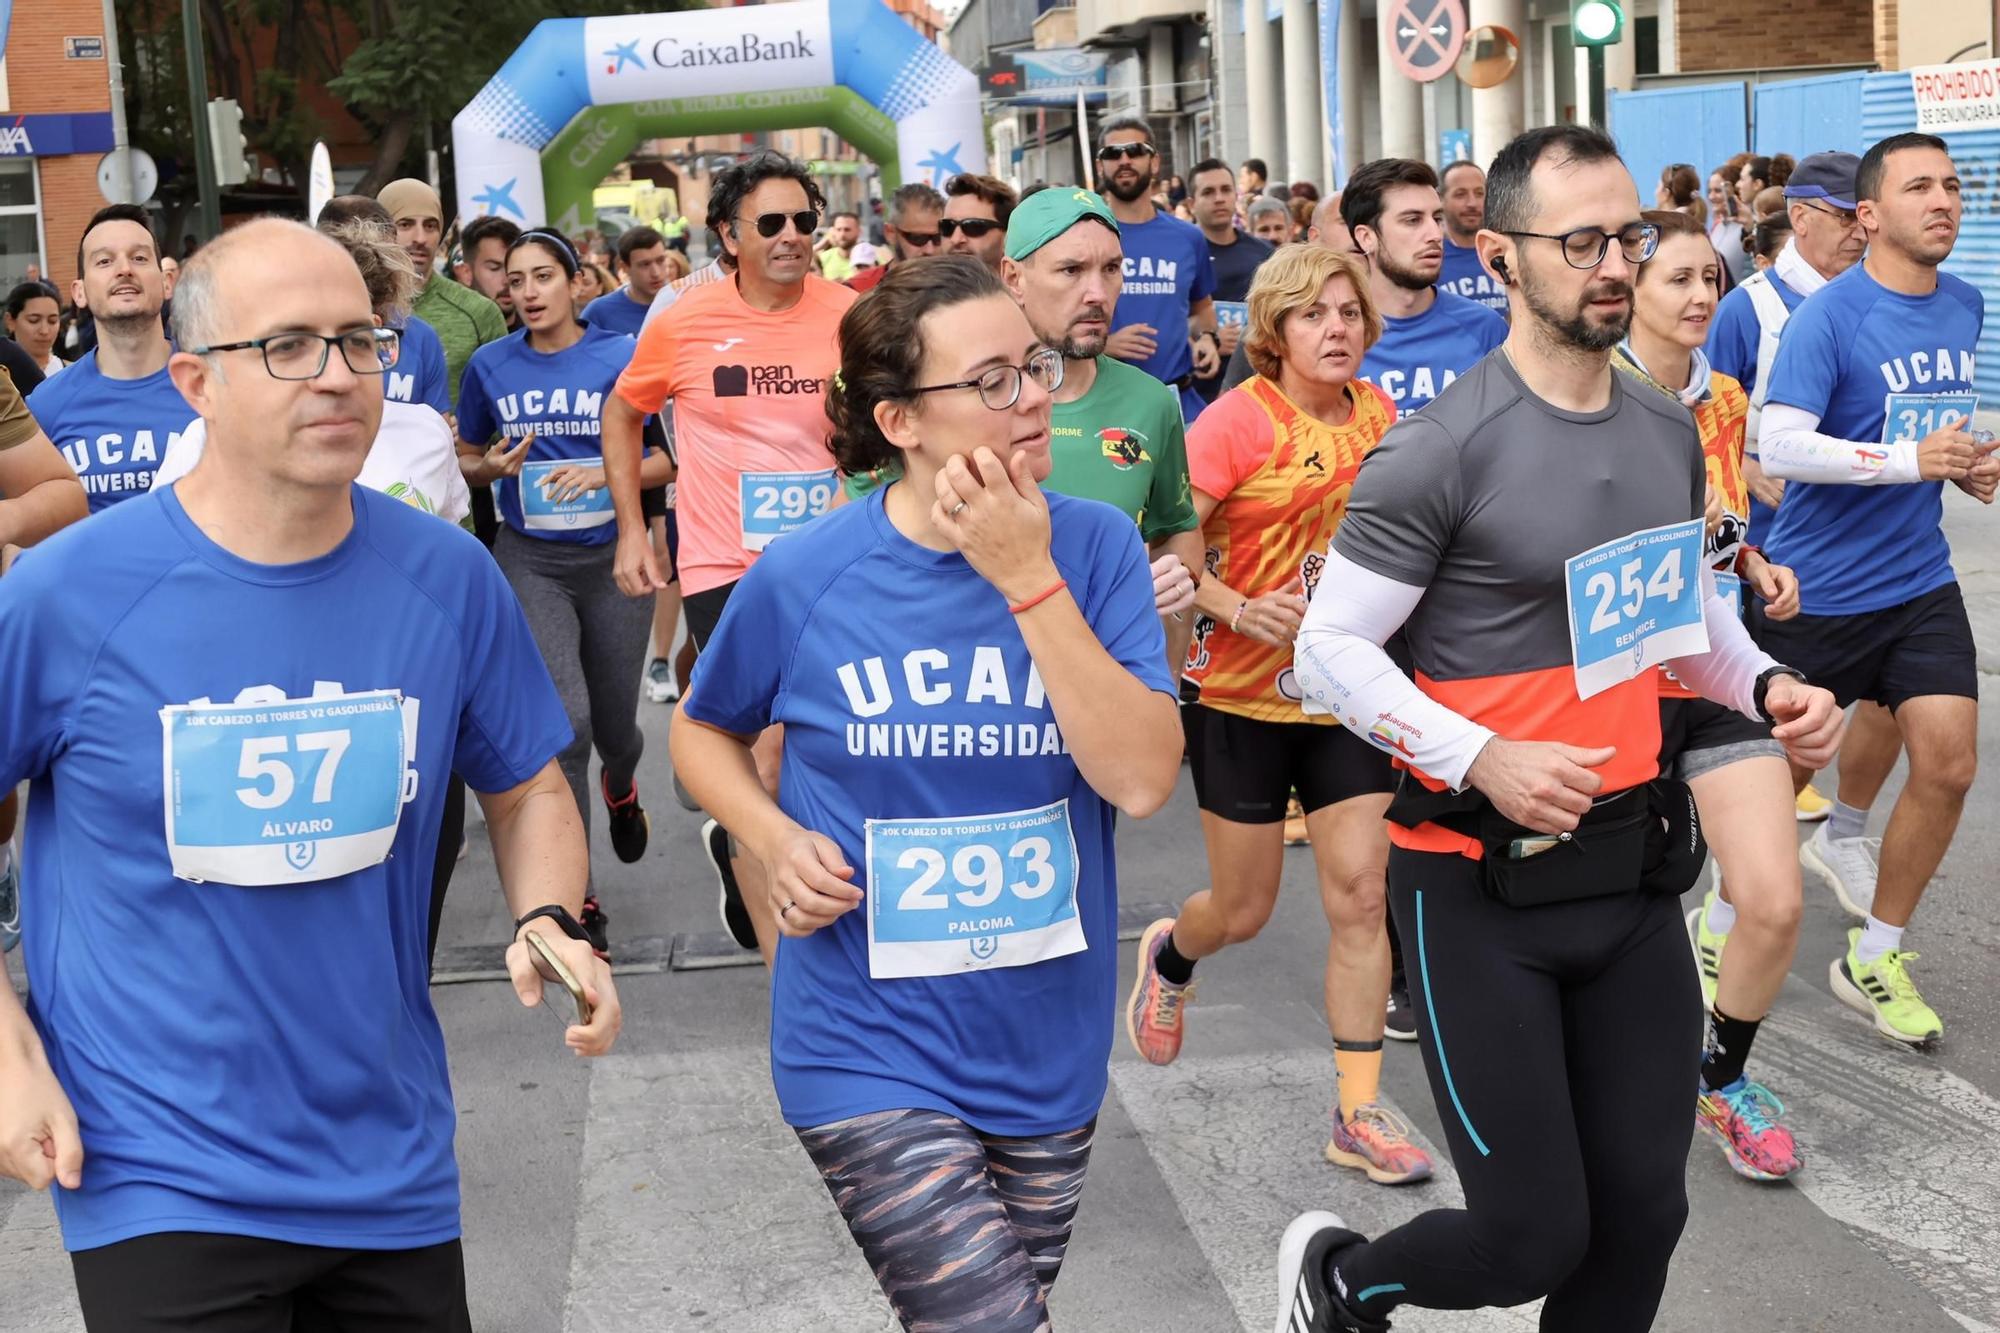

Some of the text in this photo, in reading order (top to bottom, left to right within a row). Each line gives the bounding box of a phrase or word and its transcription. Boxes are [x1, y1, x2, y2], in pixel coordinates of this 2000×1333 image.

[652, 31, 815, 68] CaixaBank
[1916, 69, 1993, 102] PROHIBIDO
[1922, 109, 1933, 124] SE
[751, 365, 793, 385] pan
[1880, 348, 1975, 393] UCAM
[497, 388, 602, 422] UCAM
[502, 420, 601, 438] UNIVERSIDAD
[753, 484, 831, 518] 299
[1586, 552, 1608, 567] CABEZO
[1649, 527, 1698, 544] GASOLINERAS
[1585, 548, 1685, 635] 254
[1616, 631, 1635, 648] BEN
[186, 701, 394, 726] 10K CABEZO DE TORRES V2 GASOLINERAS
[846, 723, 1070, 757] UNIVERSIDA
[236, 729, 351, 809] 57
[261, 818, 333, 837] ÁLVARO
[882, 810, 1063, 837] 10K CABEZO DE TORRES V2 GASOLINERAS
[296, 843, 306, 859] 2
[896, 836, 1056, 911] 293
[948, 916, 1015, 934] PALOMA
[979, 938, 989, 951] 2
